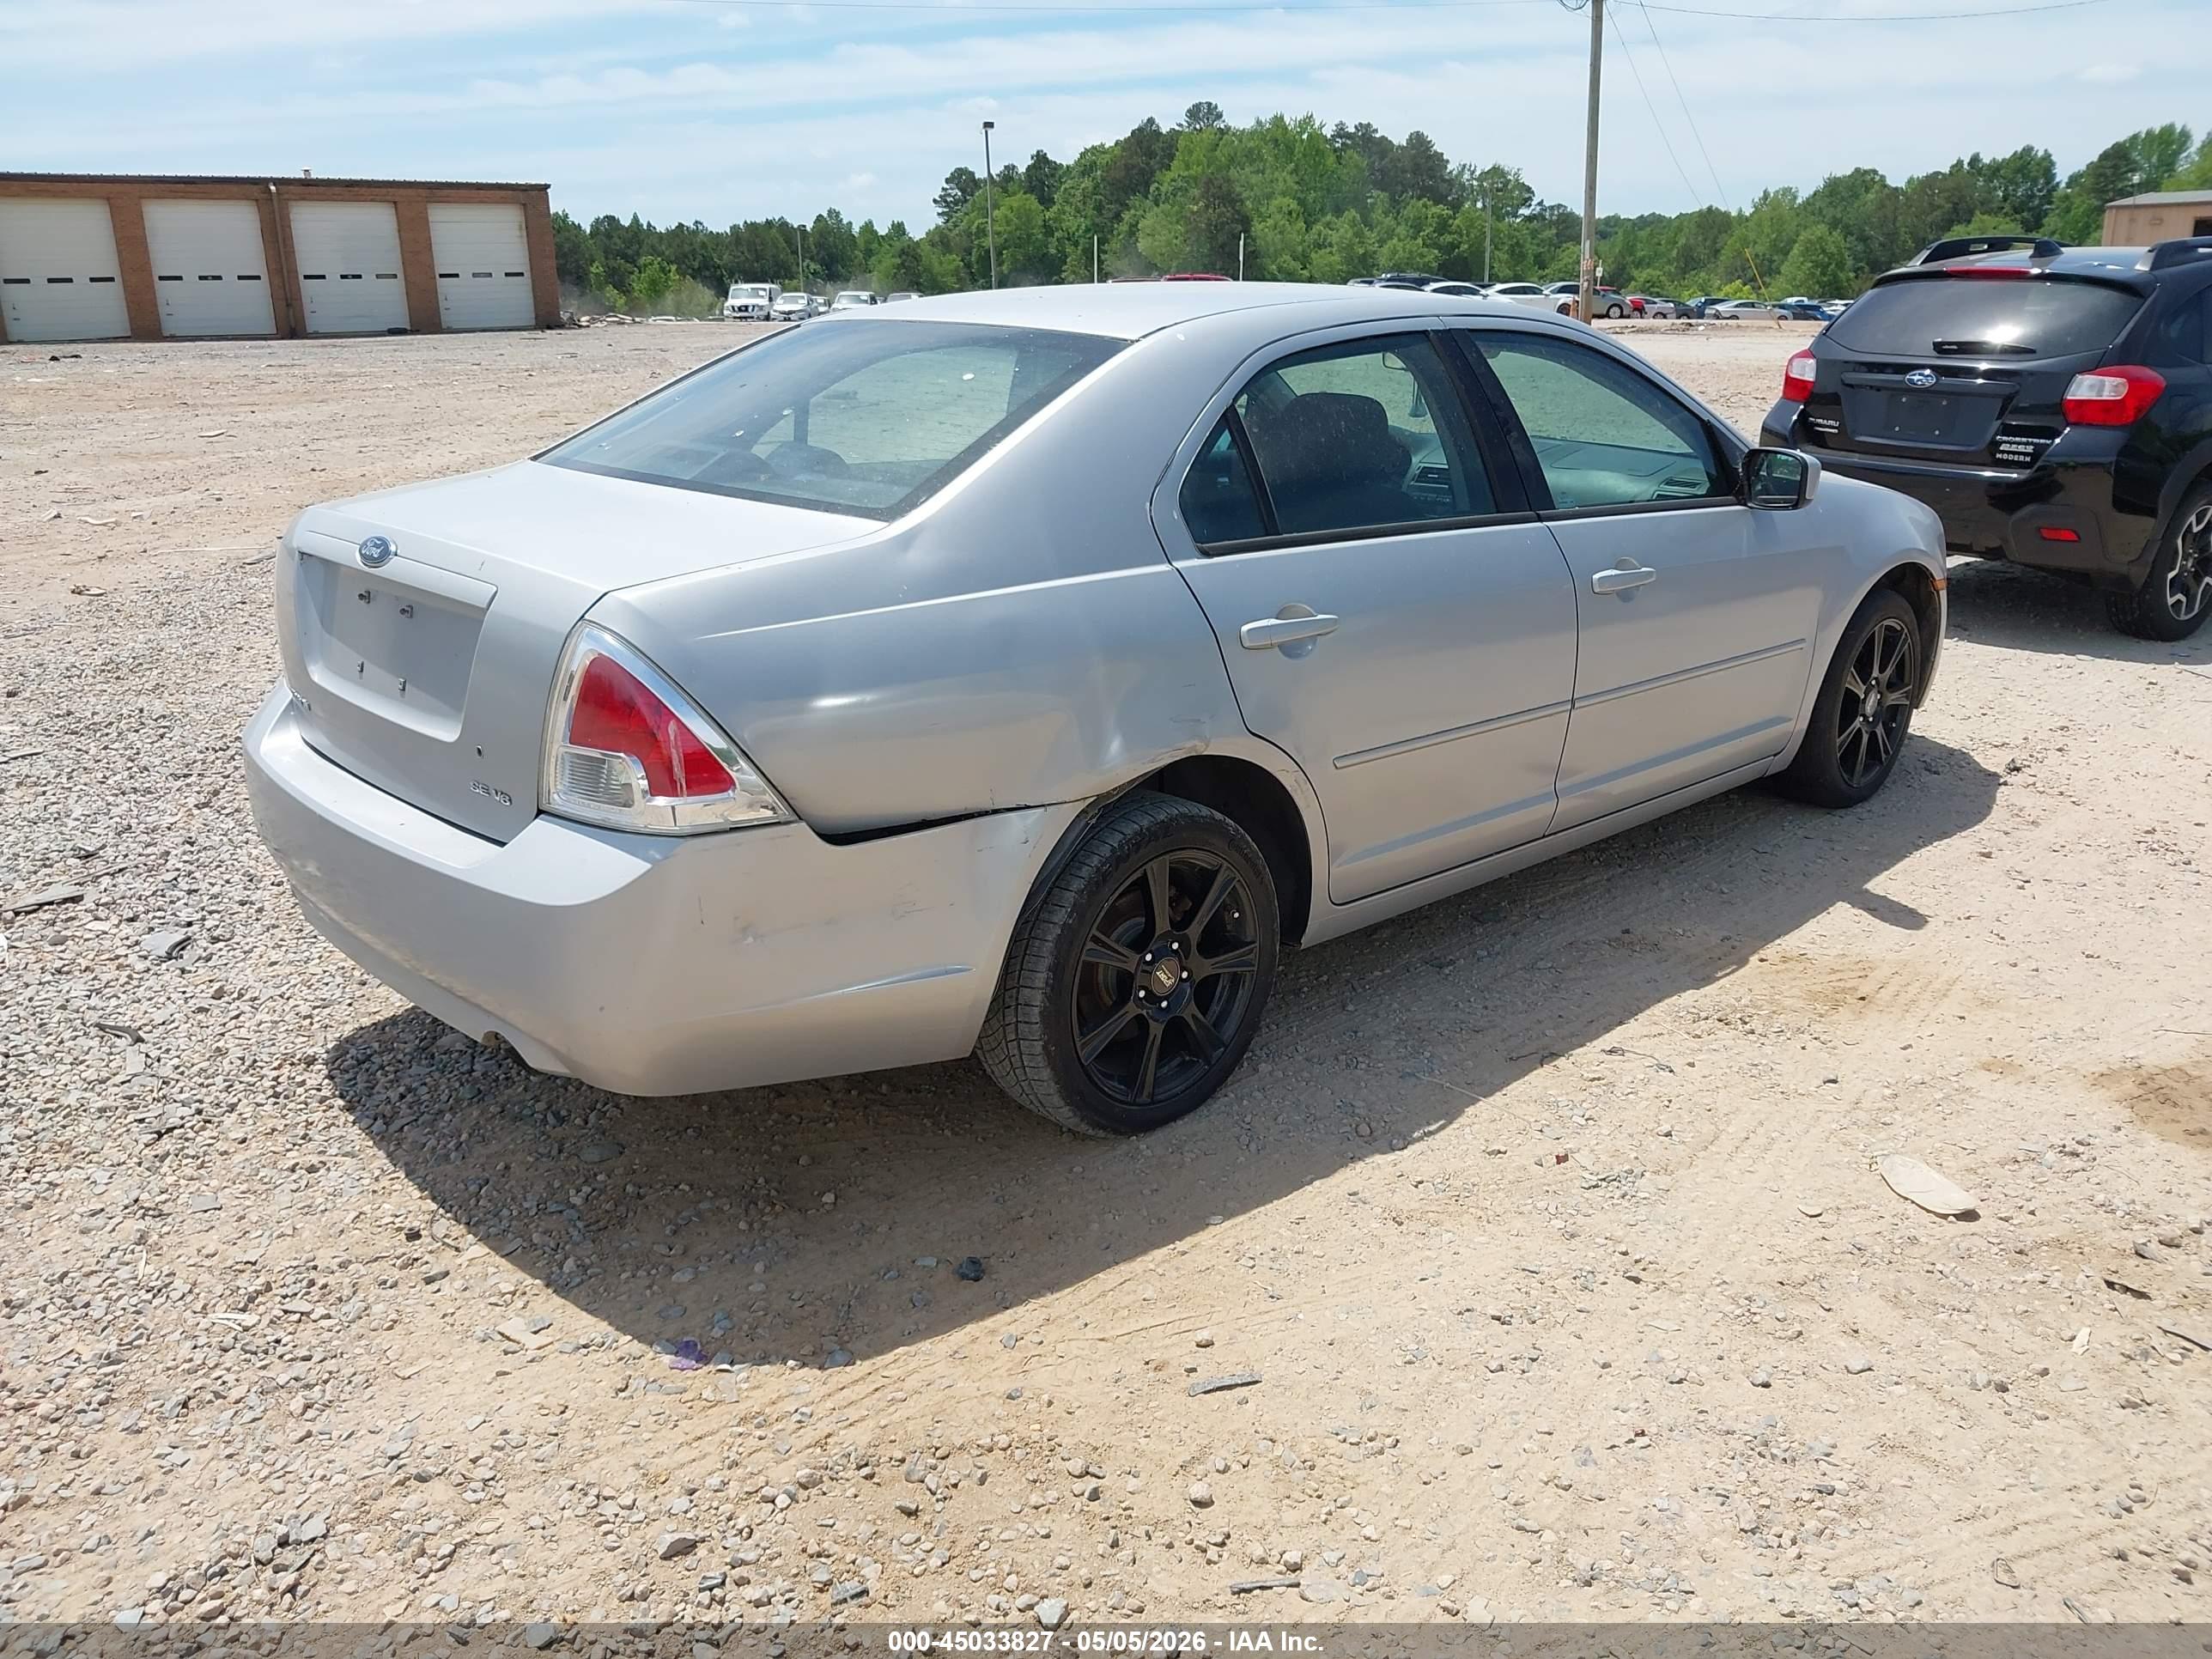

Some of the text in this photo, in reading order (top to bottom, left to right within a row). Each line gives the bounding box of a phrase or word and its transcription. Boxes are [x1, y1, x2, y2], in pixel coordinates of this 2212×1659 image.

[1996, 453, 2032, 463] MODERN
[362, 538, 385, 558] Ford
[470, 781, 513, 806] SE V6
